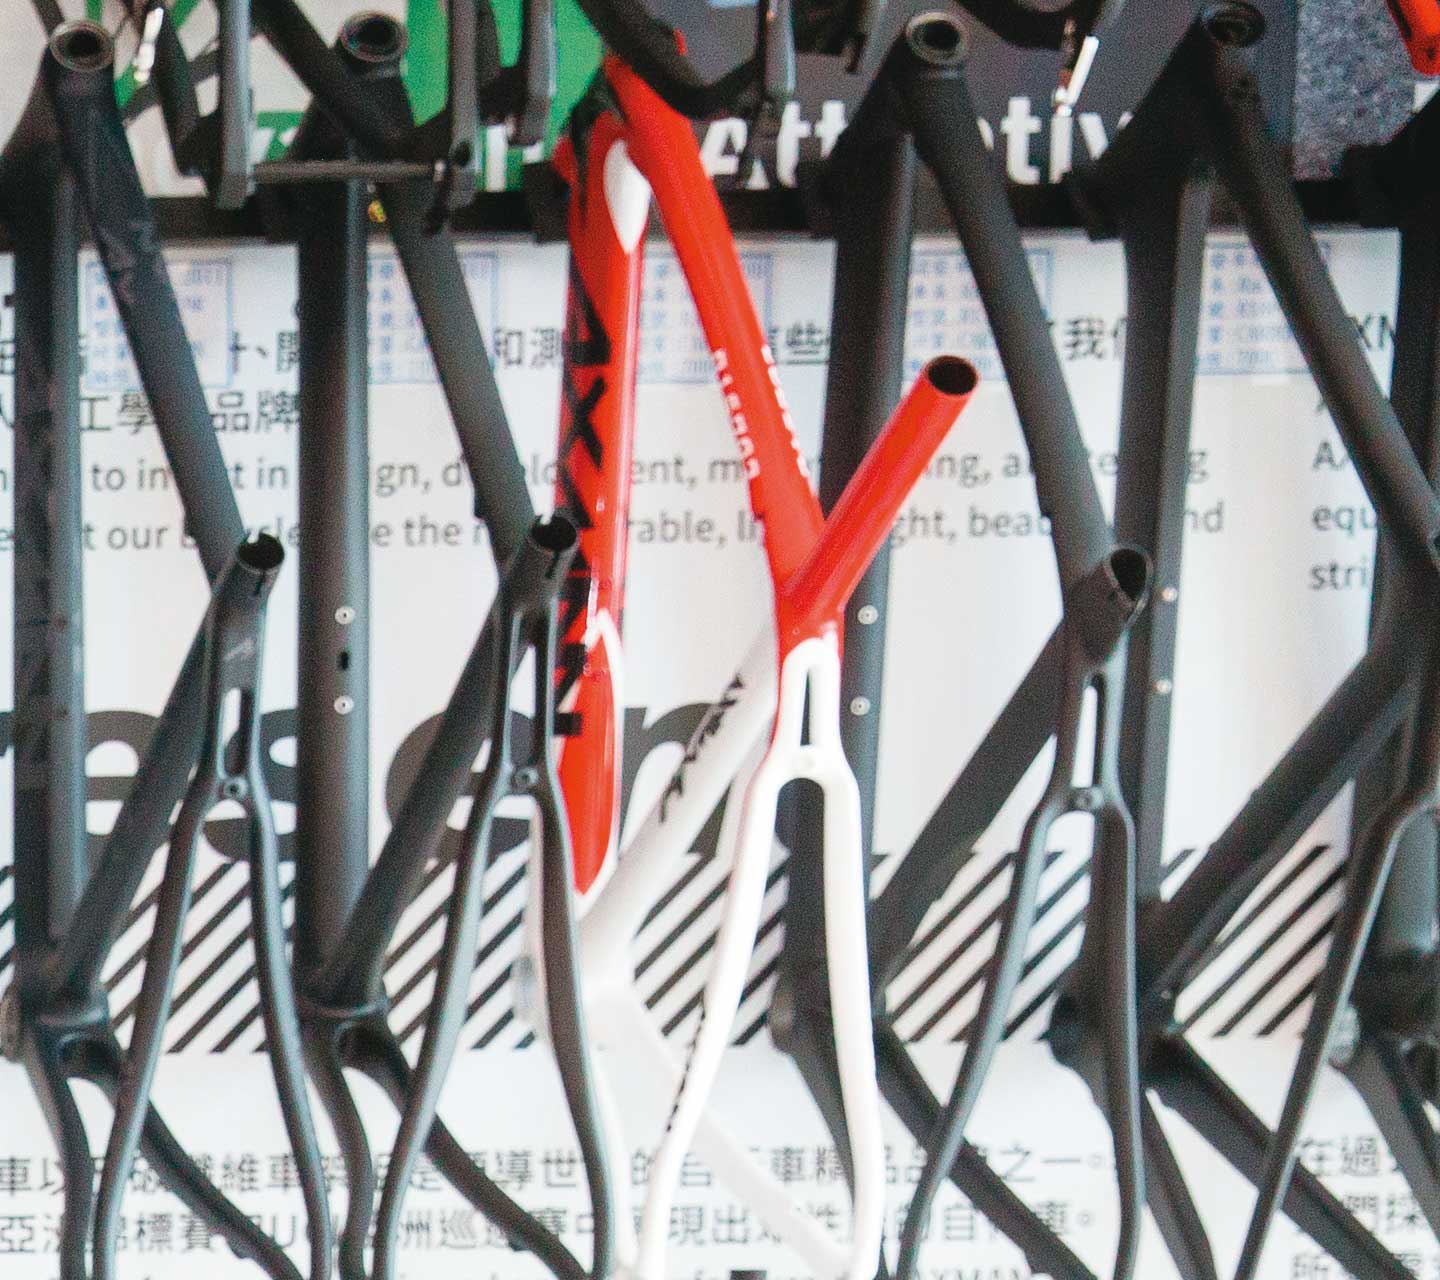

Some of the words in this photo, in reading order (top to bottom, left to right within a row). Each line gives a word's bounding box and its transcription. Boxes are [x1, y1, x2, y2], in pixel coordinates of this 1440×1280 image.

[91, 464, 125, 492] to
[257, 458, 288, 491] in
[107, 523, 168, 550] our
